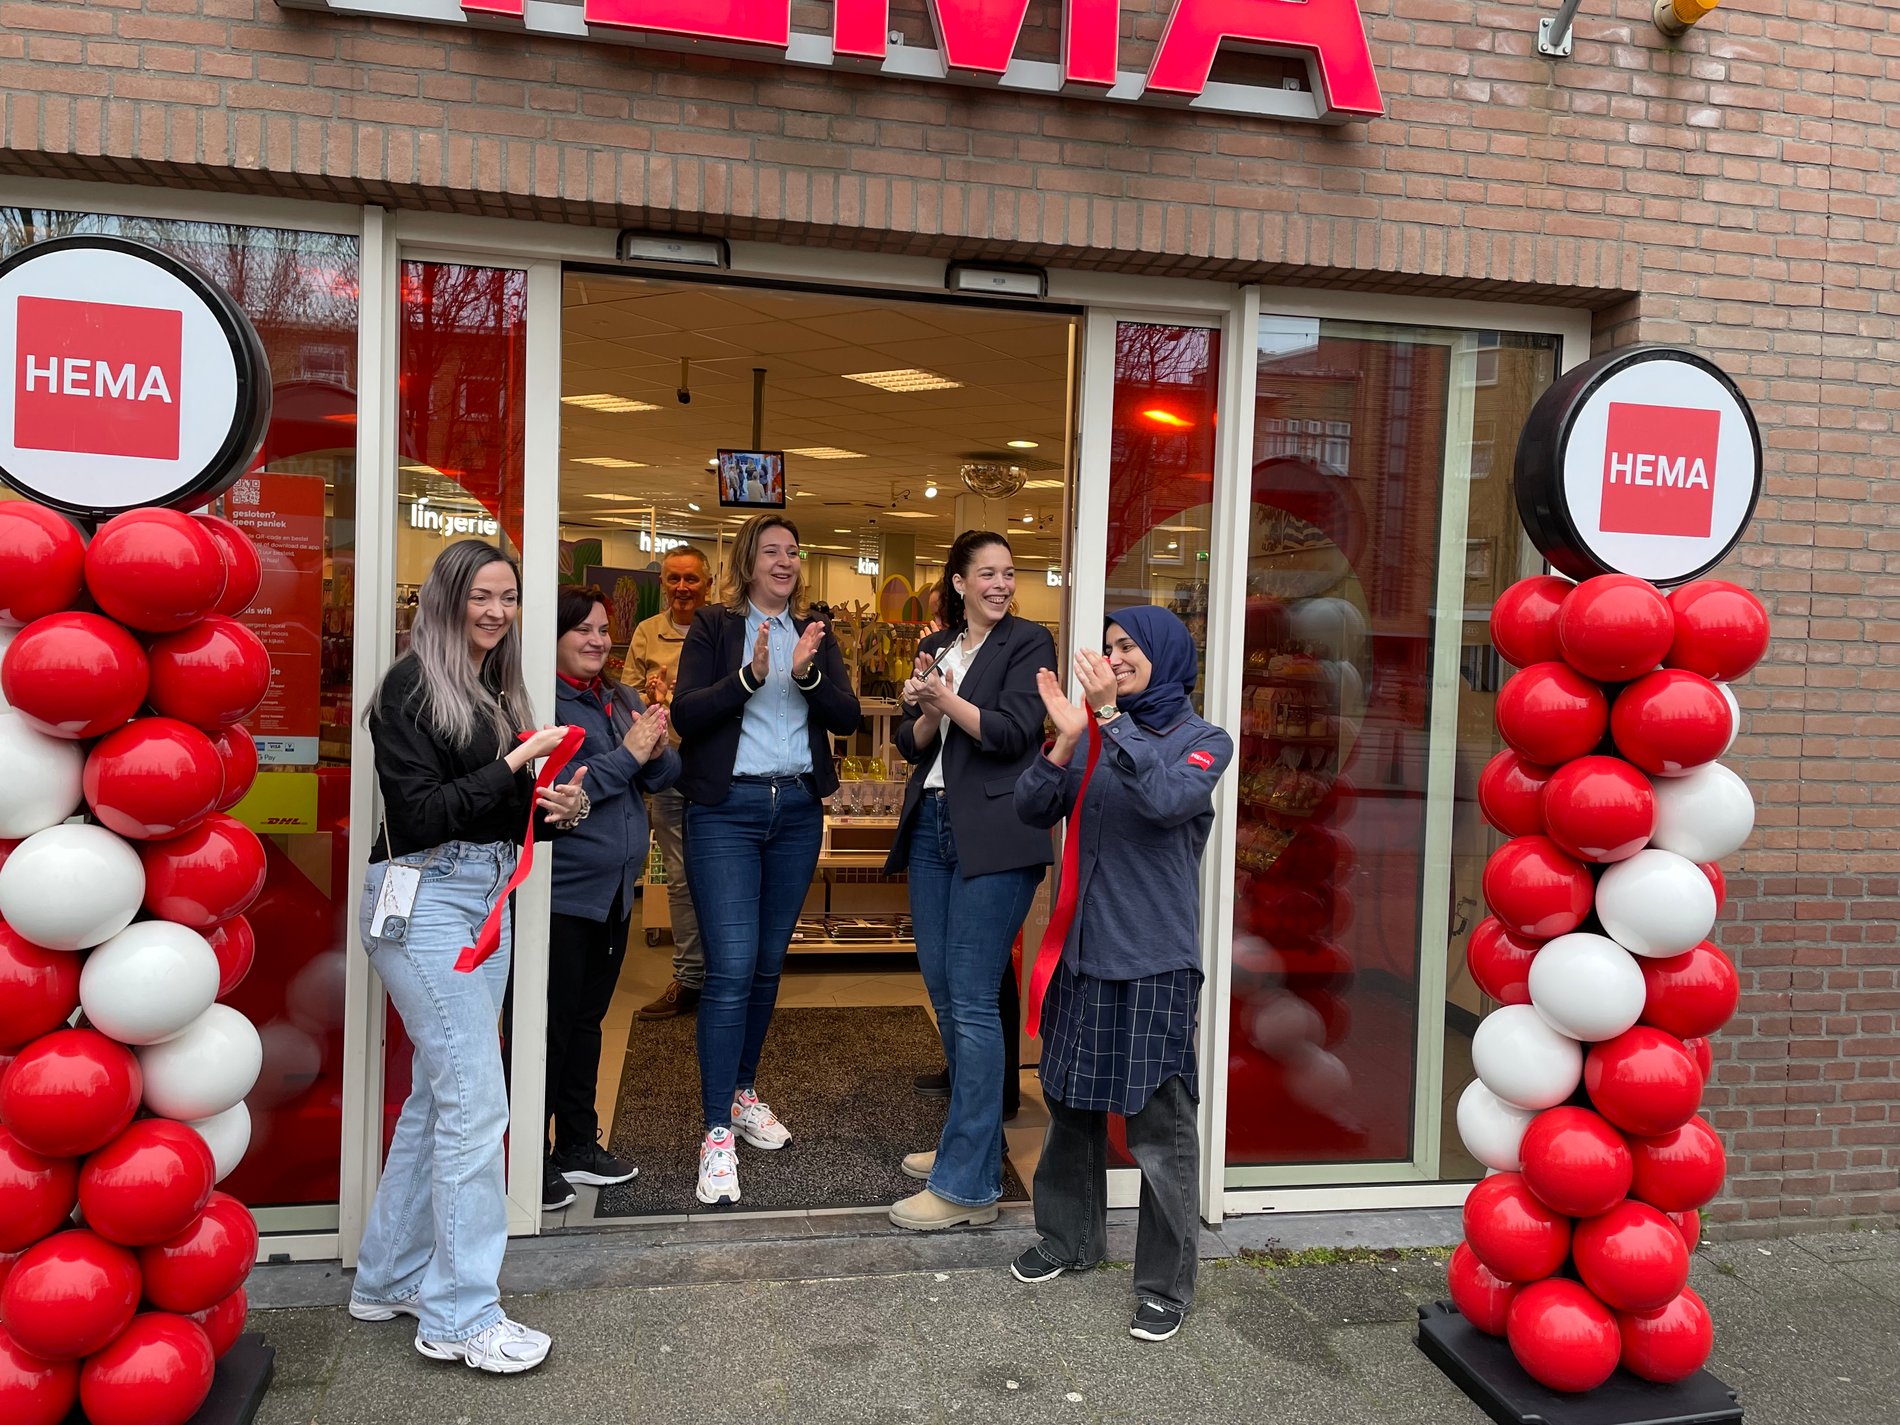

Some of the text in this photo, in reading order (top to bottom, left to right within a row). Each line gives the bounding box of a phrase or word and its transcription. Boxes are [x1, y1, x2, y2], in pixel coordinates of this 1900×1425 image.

[25, 354, 172, 404] HEMA
[1609, 451, 1709, 490] HEMA
[232, 510, 276, 519] gesloten?
[257, 520, 287, 528] paniek
[411, 503, 498, 537] lingerie
[256, 607, 273, 615] wifi
[264, 753, 276, 762] Pay
[267, 817, 301, 825] DHL
